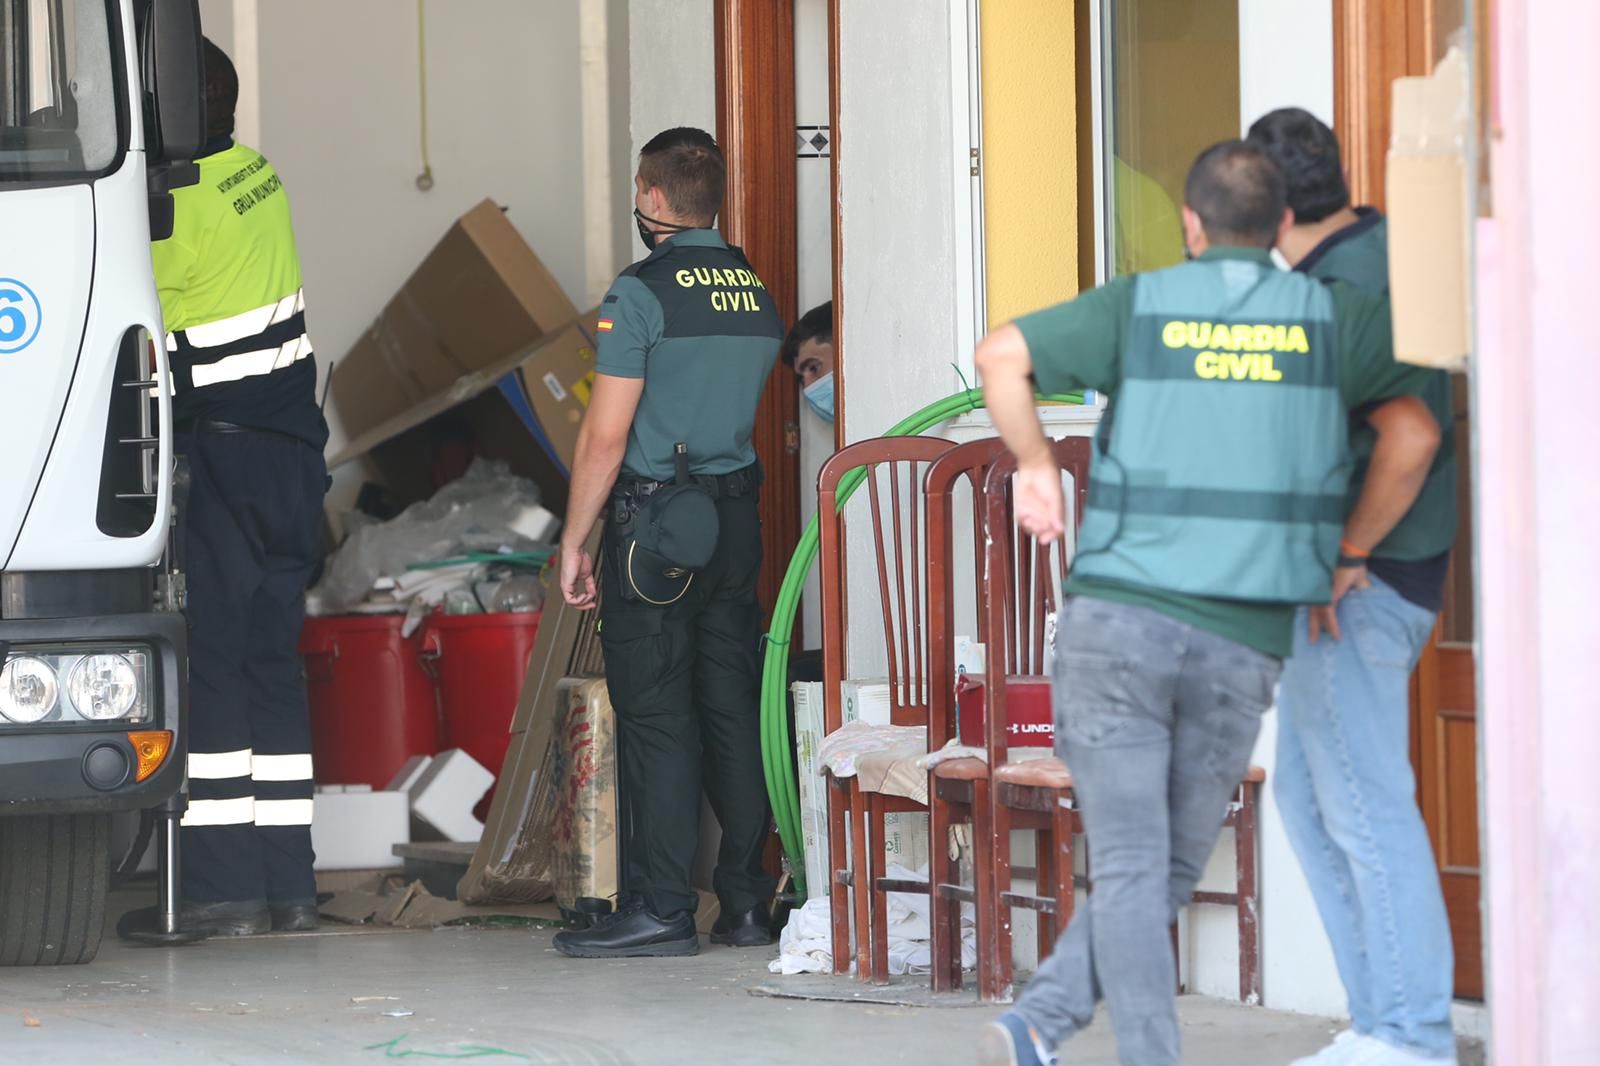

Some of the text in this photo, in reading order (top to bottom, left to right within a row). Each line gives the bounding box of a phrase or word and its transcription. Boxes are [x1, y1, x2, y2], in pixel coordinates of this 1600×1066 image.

[675, 267, 766, 290] GUARDIA
[711, 291, 760, 312] CIVIL
[1162, 321, 1309, 353] GUARDIA
[1194, 351, 1282, 381] CIVIL
[1021, 724, 1055, 733] UND
